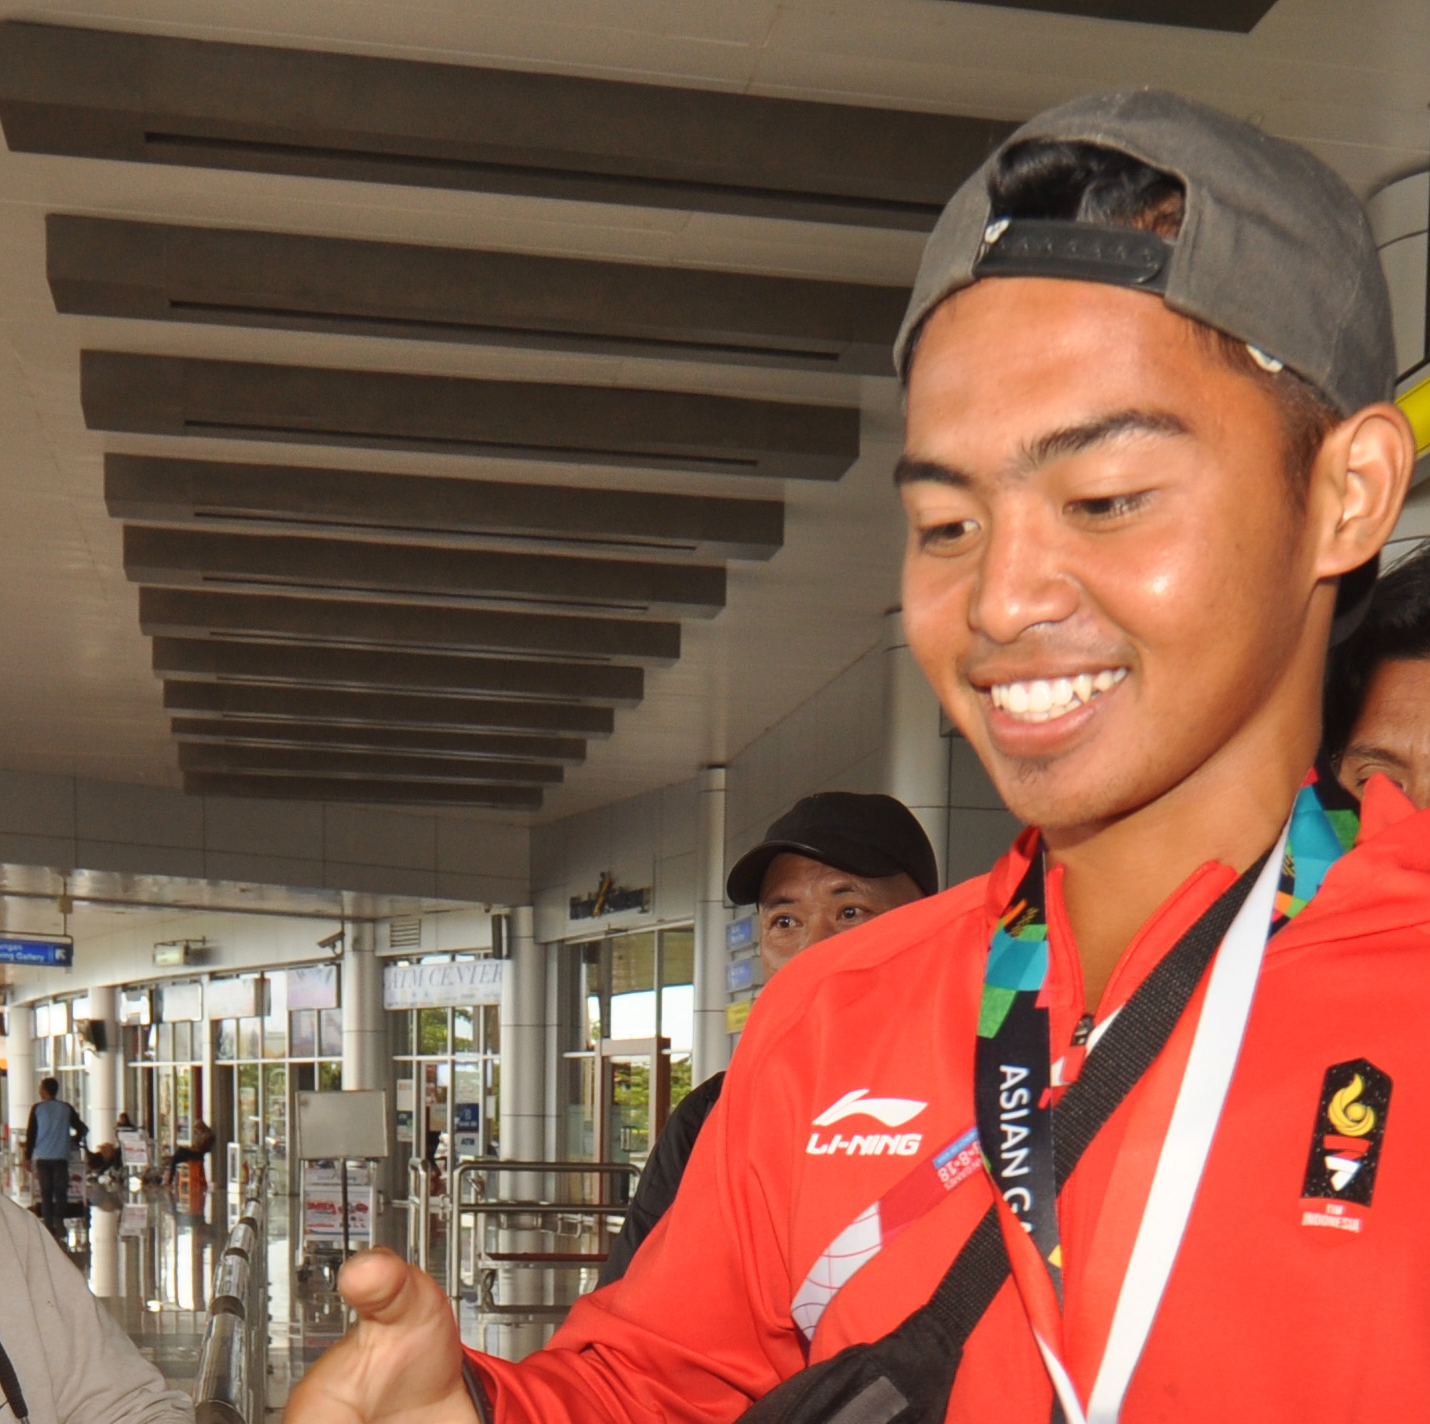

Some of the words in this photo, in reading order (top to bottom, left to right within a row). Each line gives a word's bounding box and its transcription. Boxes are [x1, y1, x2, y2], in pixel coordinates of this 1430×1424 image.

[999, 1065, 1030, 1178] ASIAN
[805, 1132, 923, 1156] LI-NING
[1325, 1203, 1345, 1216] TIM
[1301, 1211, 1362, 1233] INDONESIA
